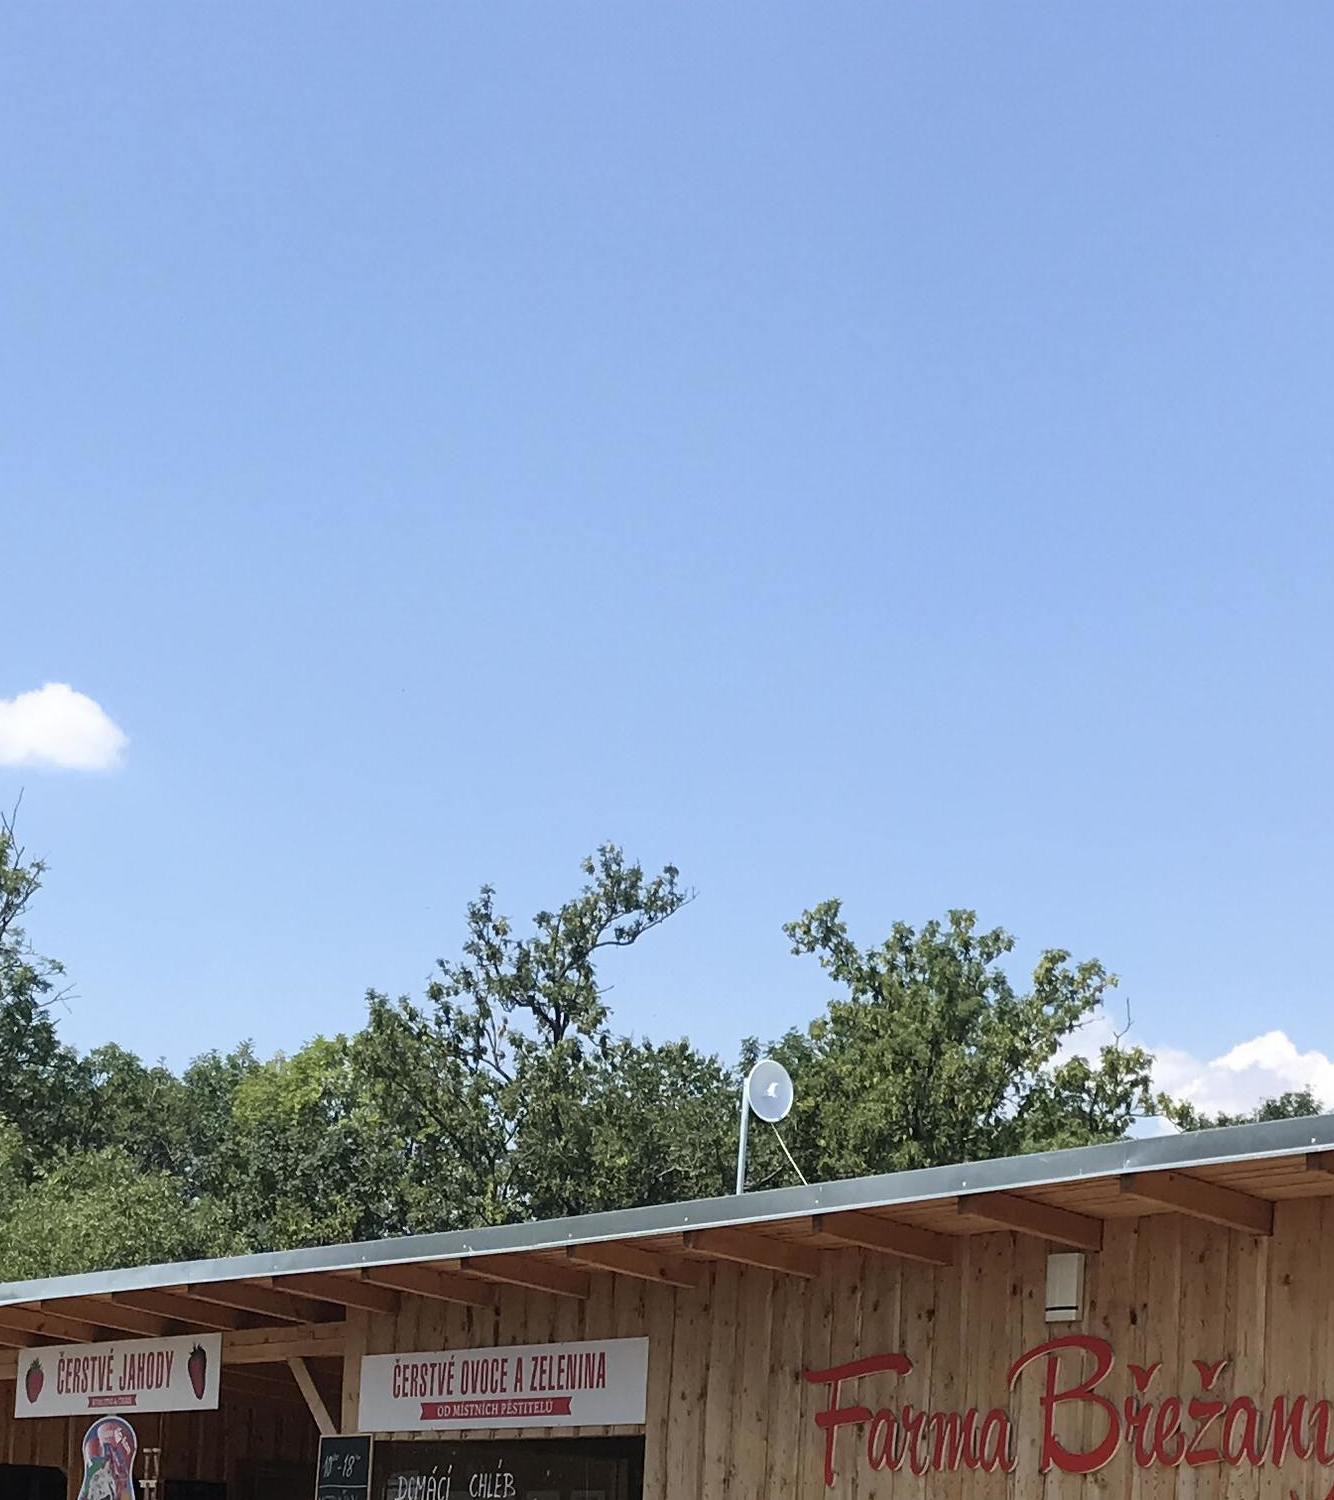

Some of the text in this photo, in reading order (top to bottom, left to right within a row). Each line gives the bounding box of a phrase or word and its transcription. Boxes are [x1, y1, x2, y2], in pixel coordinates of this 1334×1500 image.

[57, 1348, 174, 1395] ČERSTVÉ JAHODY
[392, 1352, 606, 1398] ČERSTVÉ OVOCE A ZELENINA
[437, 1399, 553, 1417] OD MÍSTNÍCH PĚSTITELŮ
[802, 1352, 1017, 1486] Farma
[469, 1459, 516, 1498] CHLÉB
